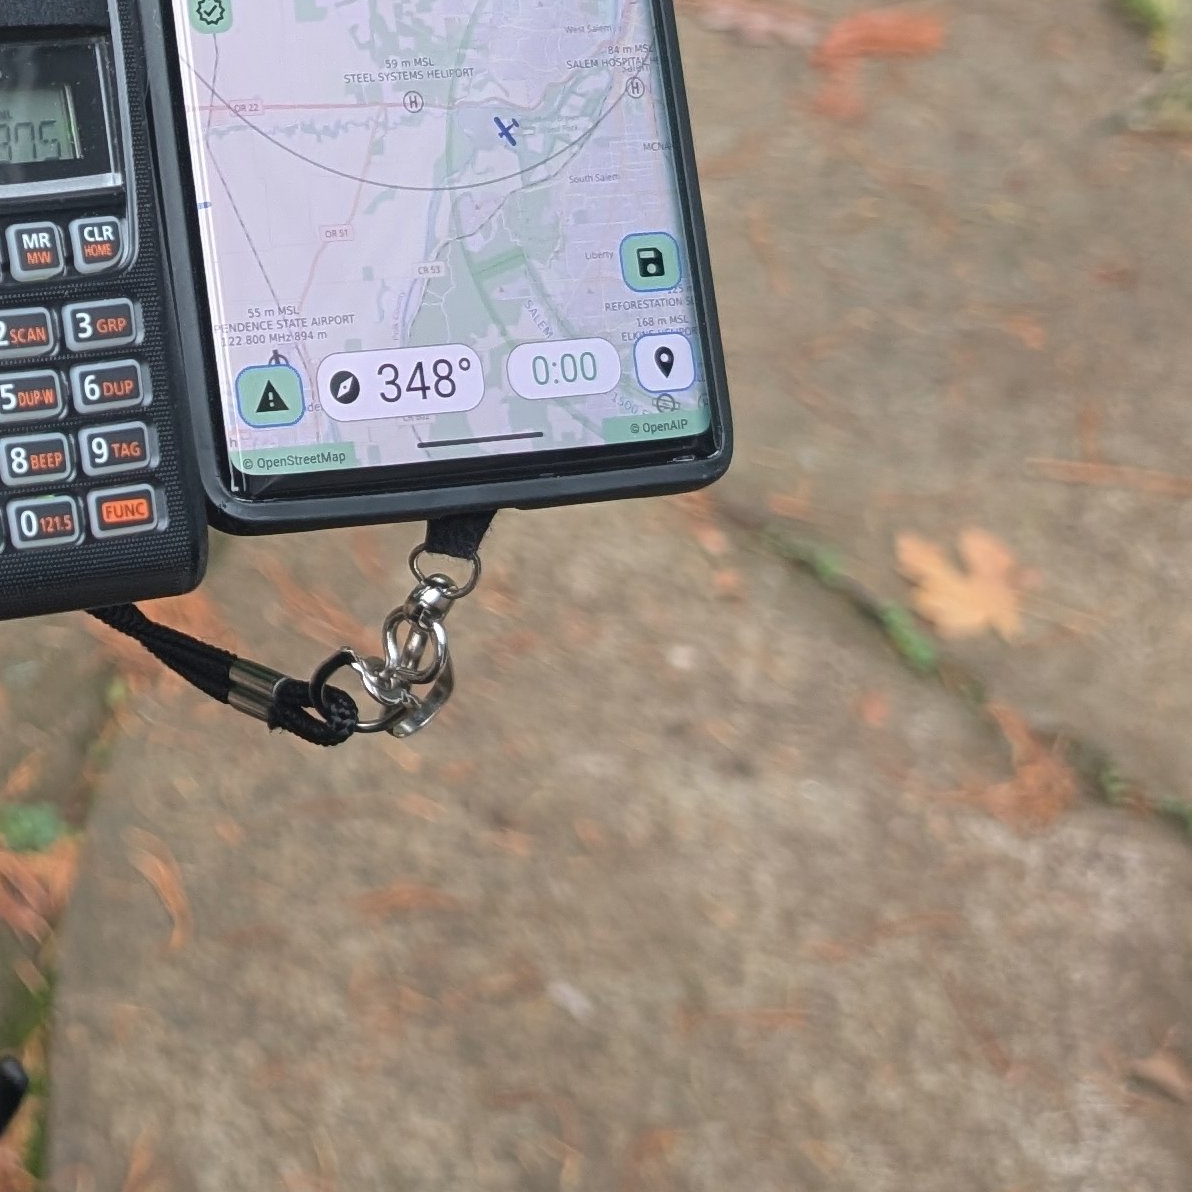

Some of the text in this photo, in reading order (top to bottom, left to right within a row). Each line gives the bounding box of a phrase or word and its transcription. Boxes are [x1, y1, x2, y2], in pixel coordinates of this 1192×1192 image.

[607, 45, 620, 55] 84
[622, 46, 632, 54] m
[385, 57, 435, 68] 59 m MSL
[566, 59, 600, 70] SALEM
[601, 57, 650, 68] HOSPITAL
[344, 67, 475, 84] STEEL SYSTEMS HELIPORT
[248, 103, 259, 112] 22
[569, 174, 593, 184] South
[21, 232, 52, 249] MR
[83, 225, 115, 243] CLR
[26, 251, 52, 266] MW
[83, 244, 113, 258] HOME
[247, 305, 300, 318] 55 m MSL
[605, 296, 683, 312] REFORESTATION
[75, 312, 128, 340] 3 GRP
[276, 317, 308, 329] STATE
[311, 314, 356, 326] AIRPORT
[524, 299, 554, 339] SALEM
[636, 314, 690, 328] 168 m MSL
[9, 326, 47, 345] SCAN
[269, 332, 293, 343] MHz
[294, 330, 315, 341] 894
[317, 331, 328, 340] m
[532, 351, 598, 386] 0:00
[83, 374, 135, 402] 6 DUP
[377, 356, 471, 403] 348°
[0, 383, 17, 411] 5
[642, 418, 688, 435] OpenAIP
[91, 437, 142, 464] 9 TAG
[10, 446, 64, 475] 8 BEEP
[256, 451, 346, 470] OpenStreetMap
[104, 501, 146, 521] FUNC
[20, 510, 73, 537] 0 121.5
